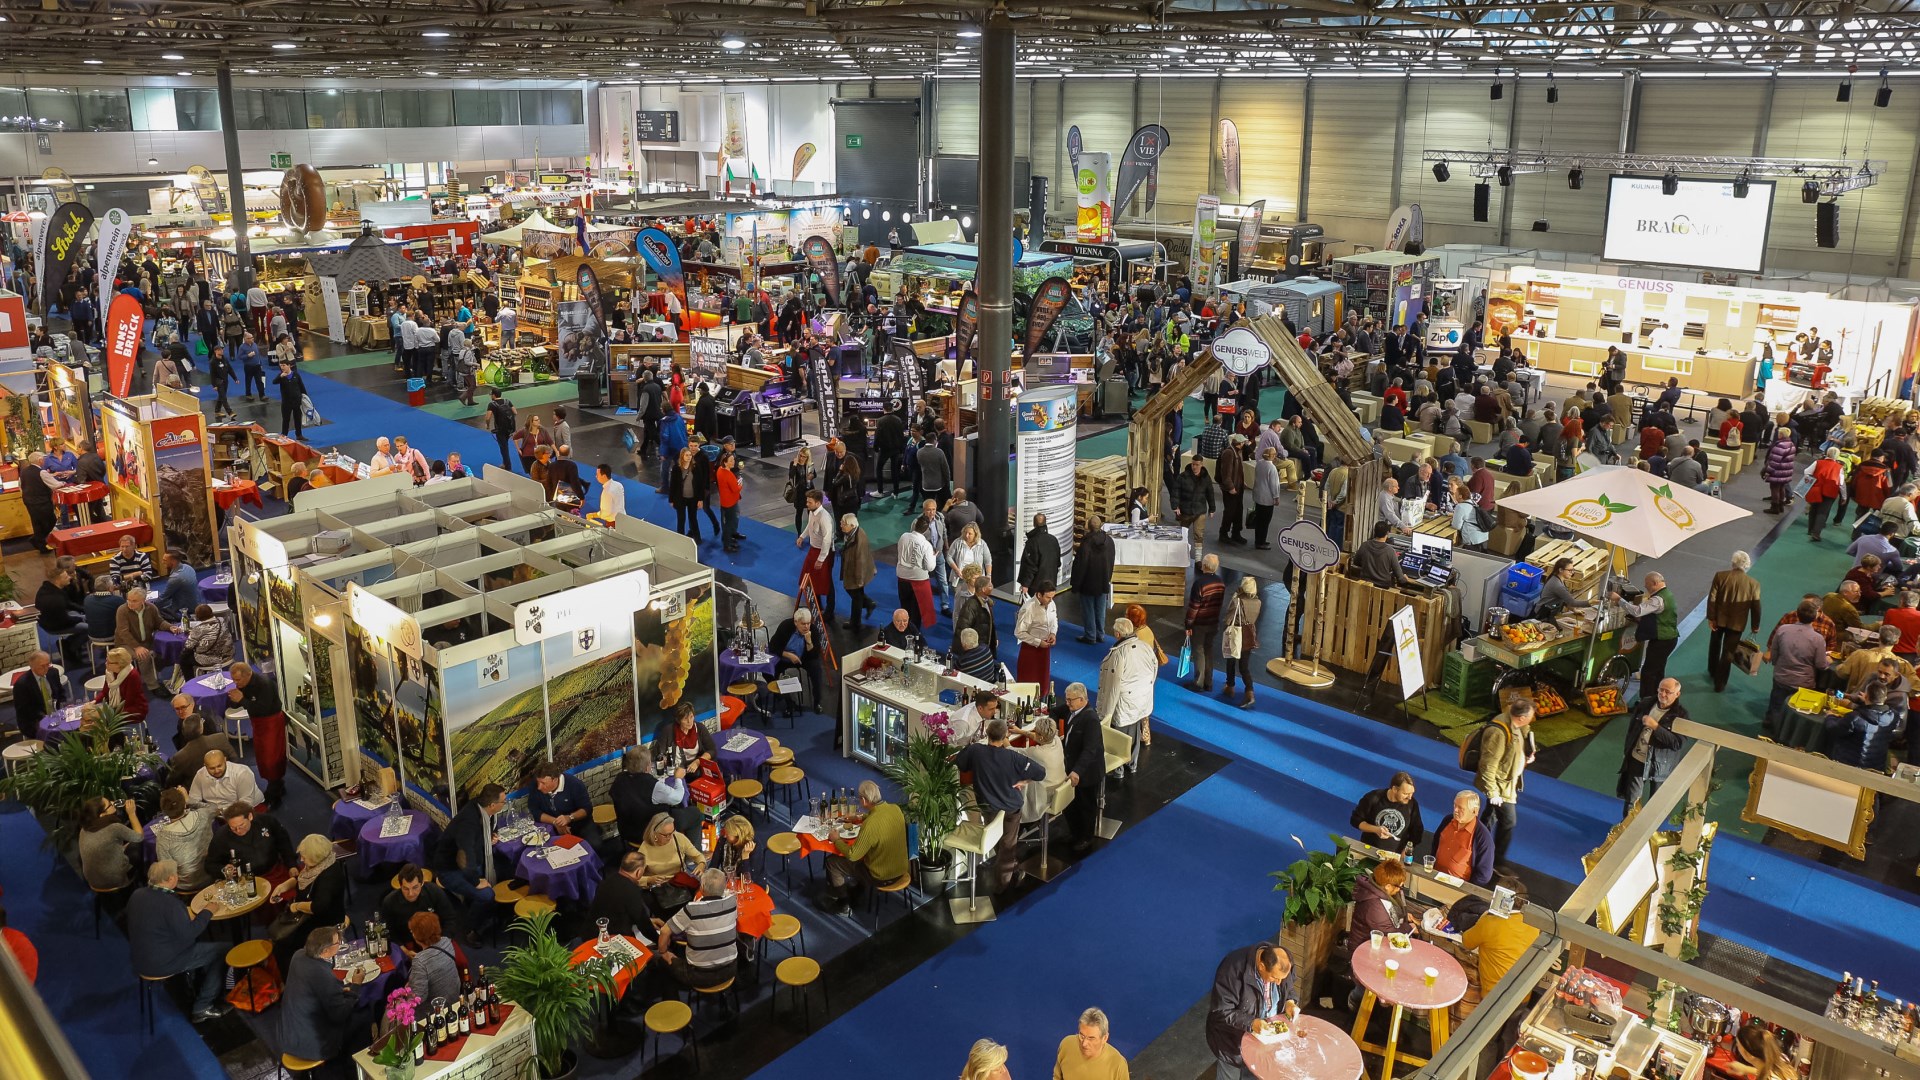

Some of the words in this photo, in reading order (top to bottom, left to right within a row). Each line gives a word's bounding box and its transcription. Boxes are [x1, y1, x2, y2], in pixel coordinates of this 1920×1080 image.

[1139, 146, 1155, 155] VIE
[99, 227, 121, 280] alpenverein
[644, 237, 671, 266] NAPOLEON
[1055, 244, 1058, 252] I
[1074, 246, 1103, 257] VIENNA
[1618, 278, 1674, 293] GENUSS
[114, 319, 129, 355] INNS'
[123, 313, 141, 358] BRUCK
[1214, 344, 1268, 359] GENUSSWELT
[867, 399, 884, 407] King
[1570, 509, 1598, 522] juice
[1577, 504, 1603, 517] hello
[1280, 536, 1336, 558] GENUSSWELT
[1481, 643, 1497, 657] hello
